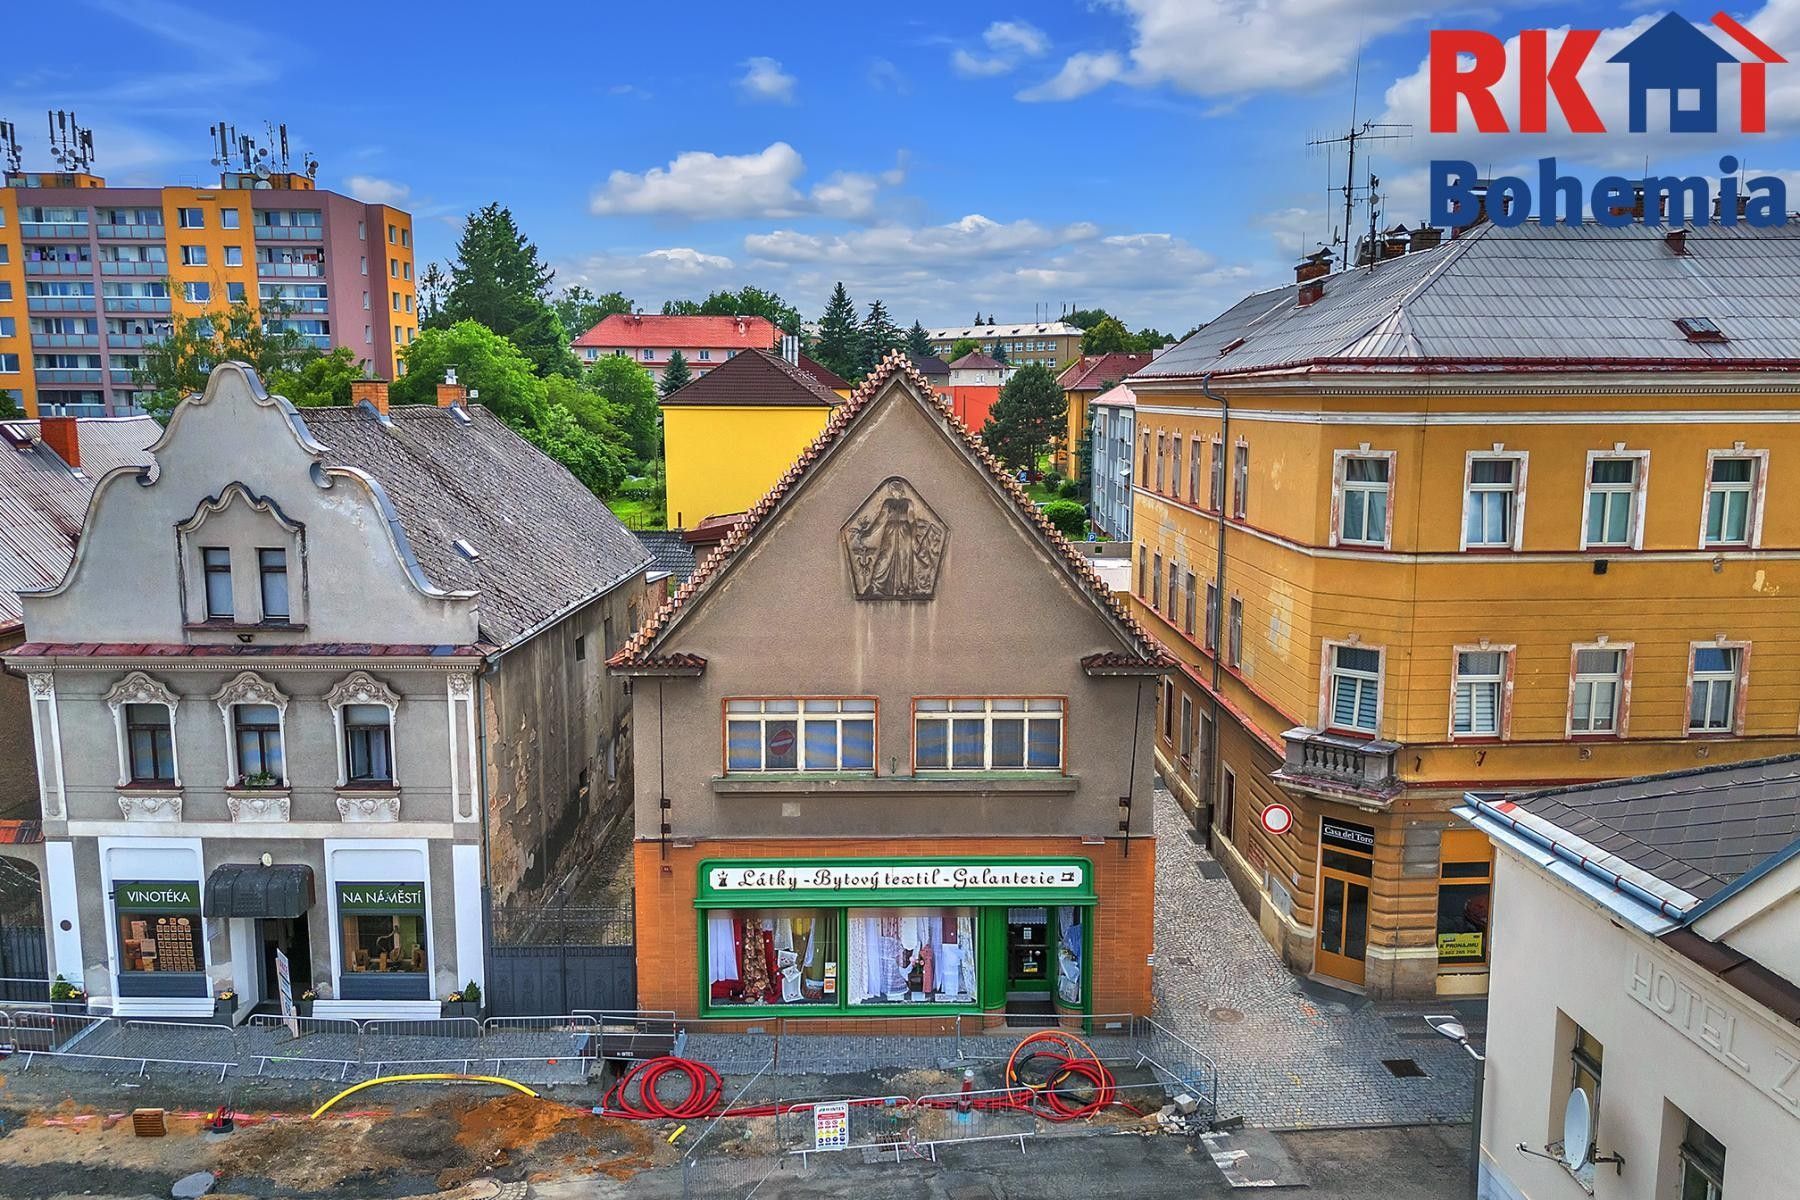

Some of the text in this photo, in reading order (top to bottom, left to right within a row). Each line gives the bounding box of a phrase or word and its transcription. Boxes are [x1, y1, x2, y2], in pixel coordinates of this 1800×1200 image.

[1324, 826, 1374, 844] Casa del Toro
[738, 869, 798, 892] Látky
[884, 867, 941, 886] textil
[126, 888, 191, 903] VINOTÉKA
[342, 889, 422, 904] NA NÁMĚSTÍ
[1632, 953, 1750, 1073] HOTEL
